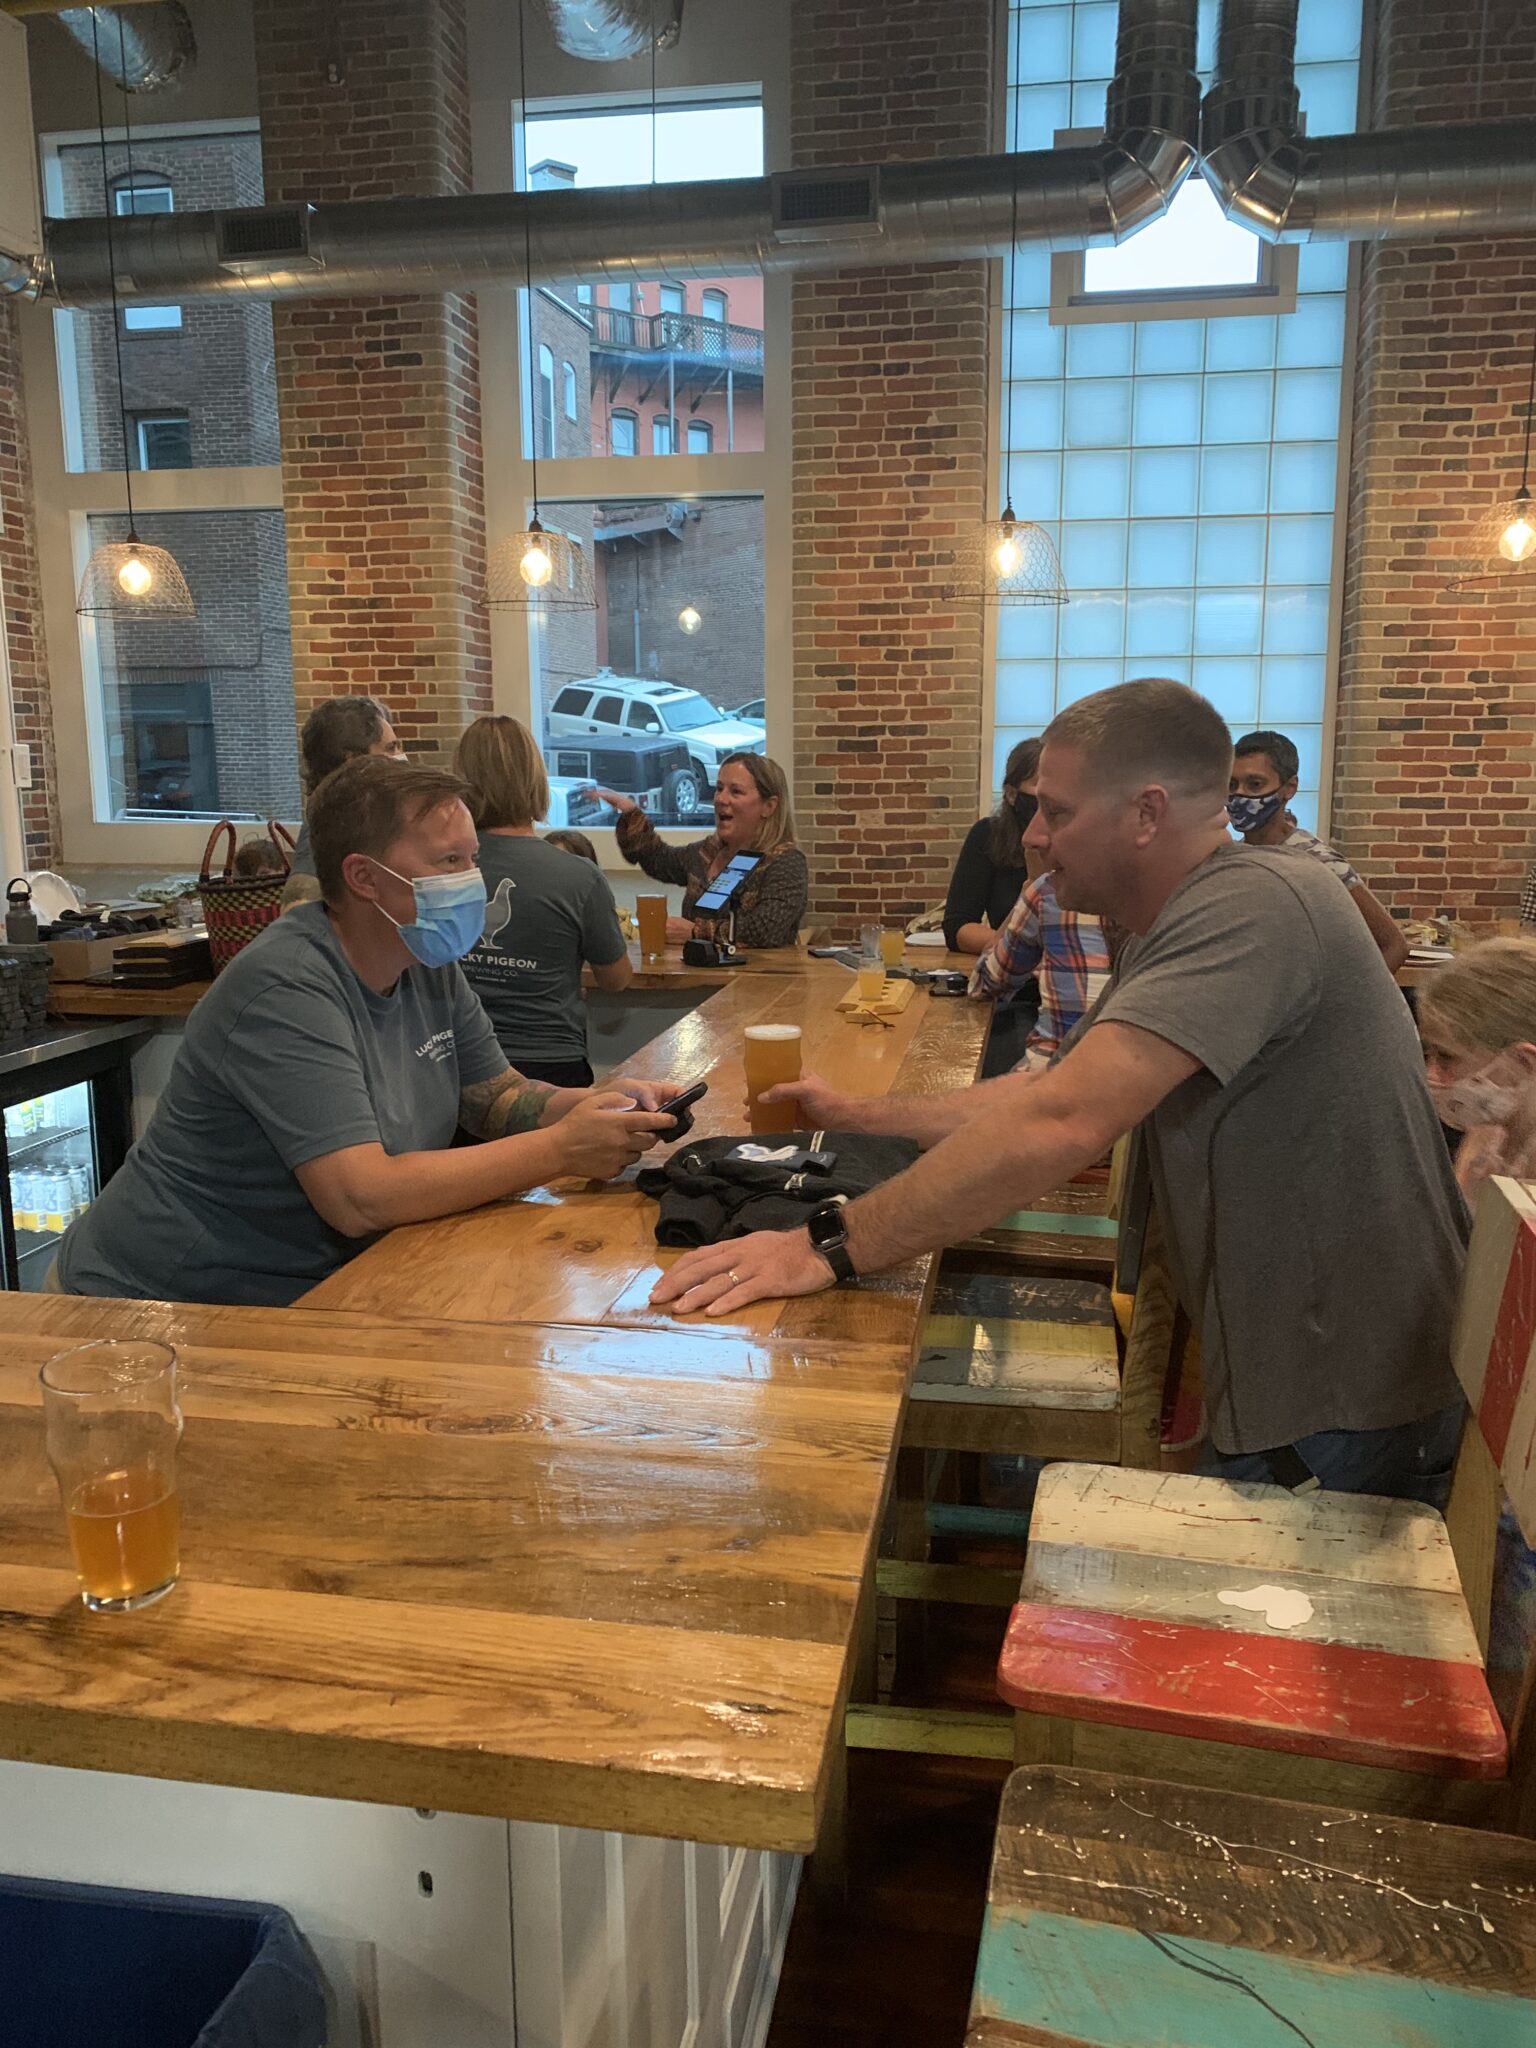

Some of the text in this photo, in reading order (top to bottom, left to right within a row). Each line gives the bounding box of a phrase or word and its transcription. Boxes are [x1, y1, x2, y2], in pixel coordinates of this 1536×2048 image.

[460, 953, 538, 970] CKY PIGEON
[431, 1029, 455, 1044] PIGE
